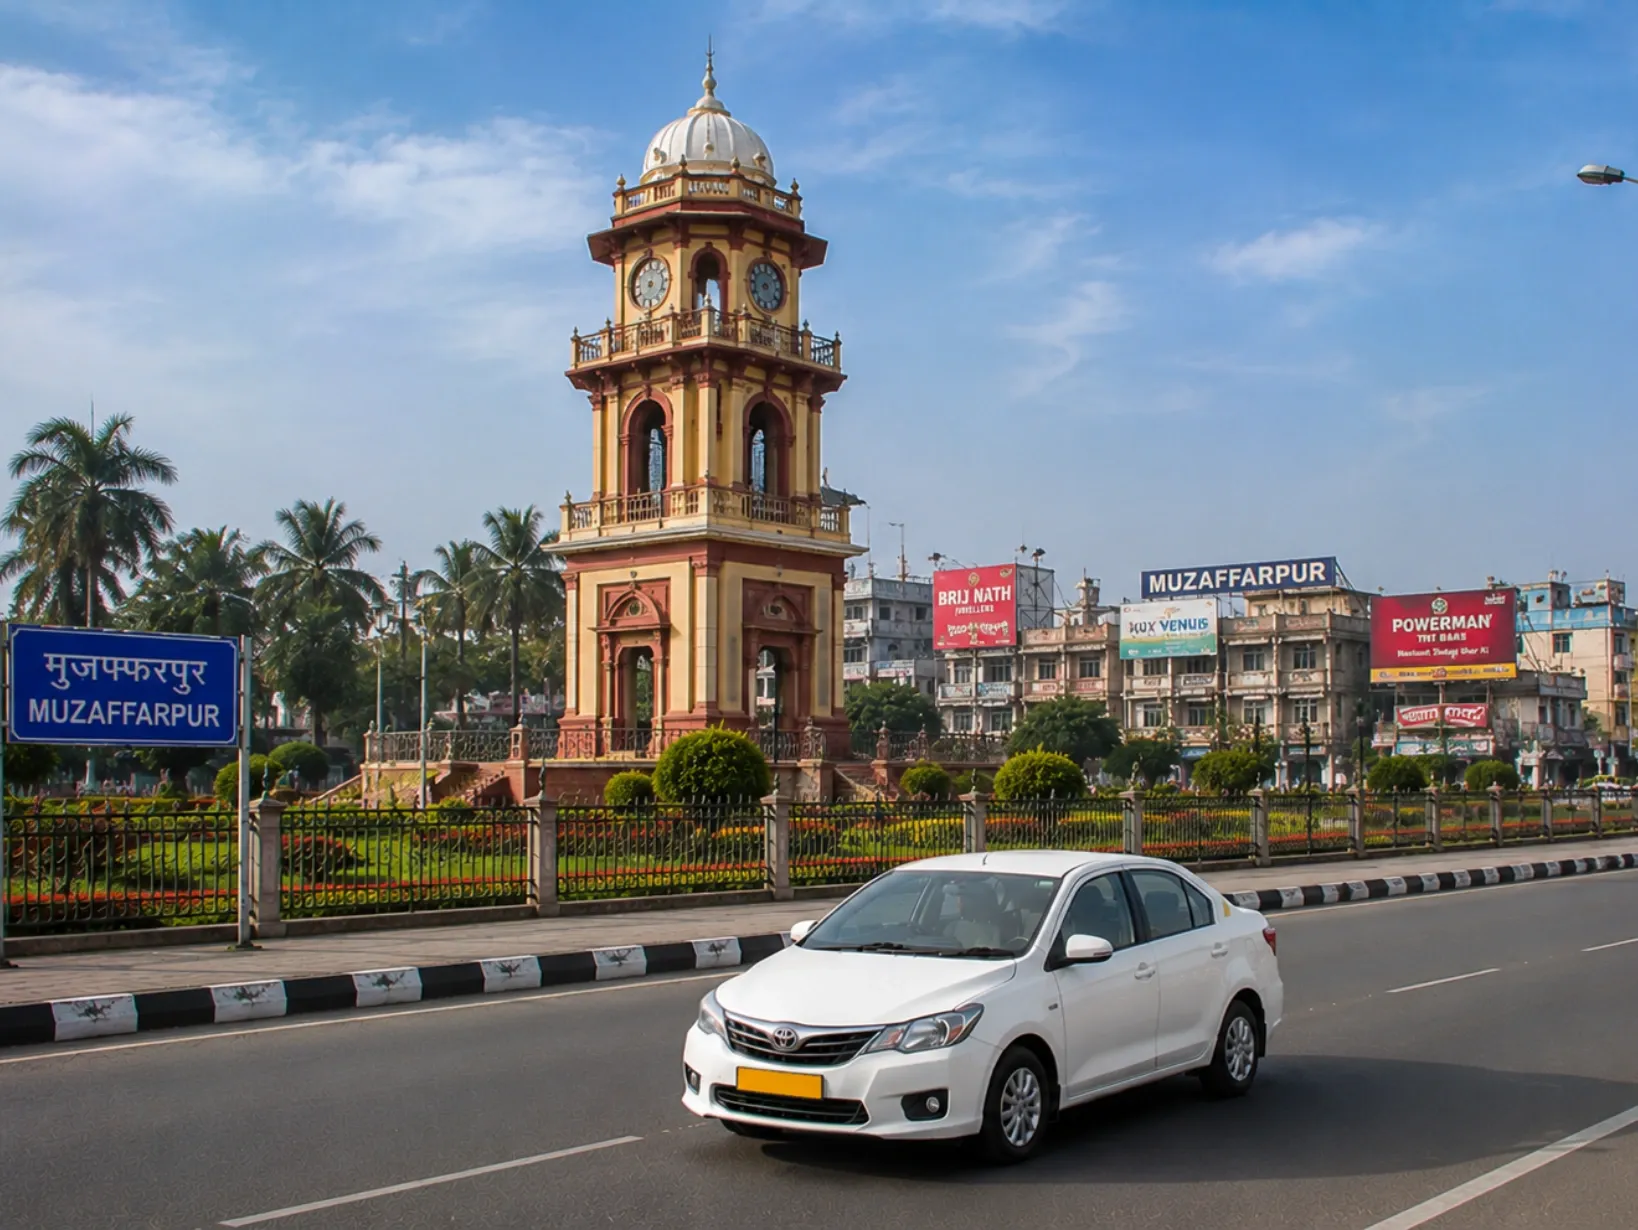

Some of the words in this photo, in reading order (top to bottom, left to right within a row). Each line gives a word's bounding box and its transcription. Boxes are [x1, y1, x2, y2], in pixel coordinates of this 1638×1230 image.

[1149, 561, 1326, 594] MUZAFFARPUR
[938, 588, 970, 606] BRIJ
[974, 584, 1012, 604] NATH
[1392, 613, 1493, 633] POWERMAN
[29, 699, 220, 727] MUZAFFARPUR
